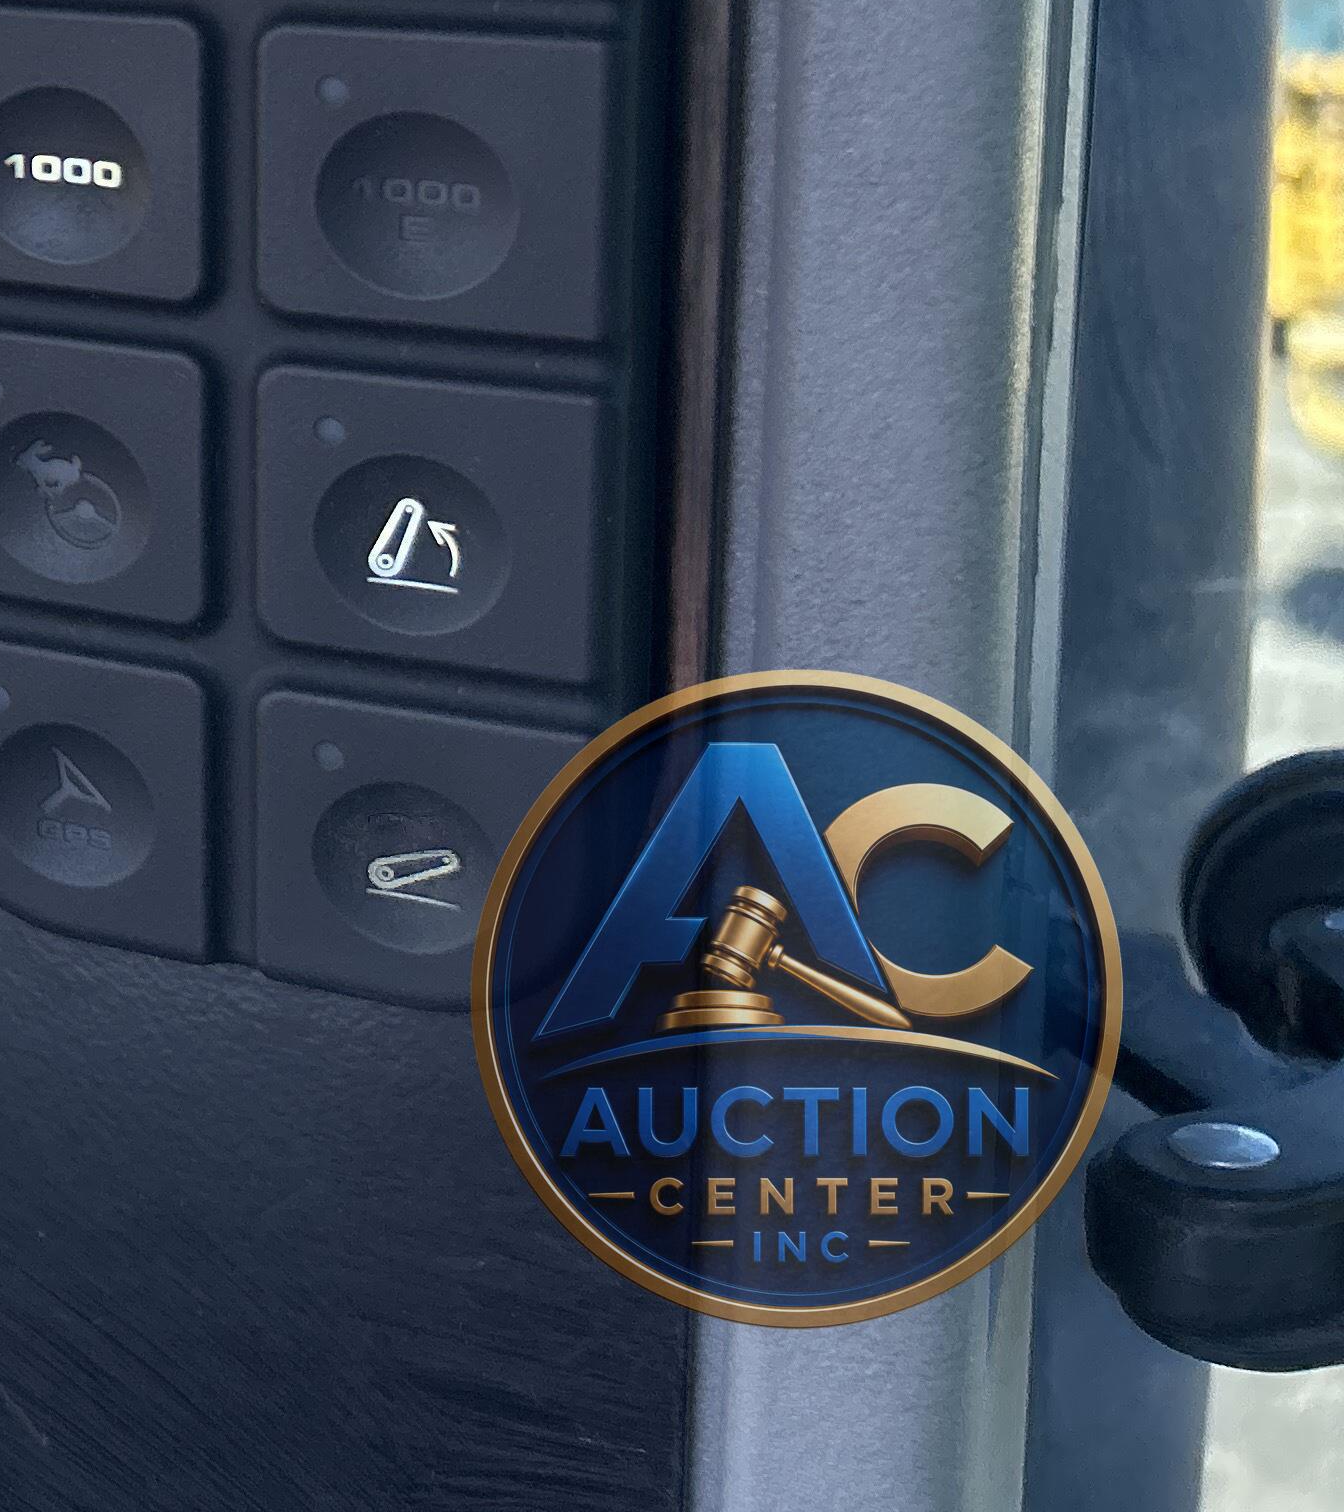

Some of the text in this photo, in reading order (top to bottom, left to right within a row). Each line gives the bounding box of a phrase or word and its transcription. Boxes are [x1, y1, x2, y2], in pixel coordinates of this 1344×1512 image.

[4, 153, 123, 189] 1000
[351, 175, 482, 211] 1000
[37, 818, 113, 851] GPS
